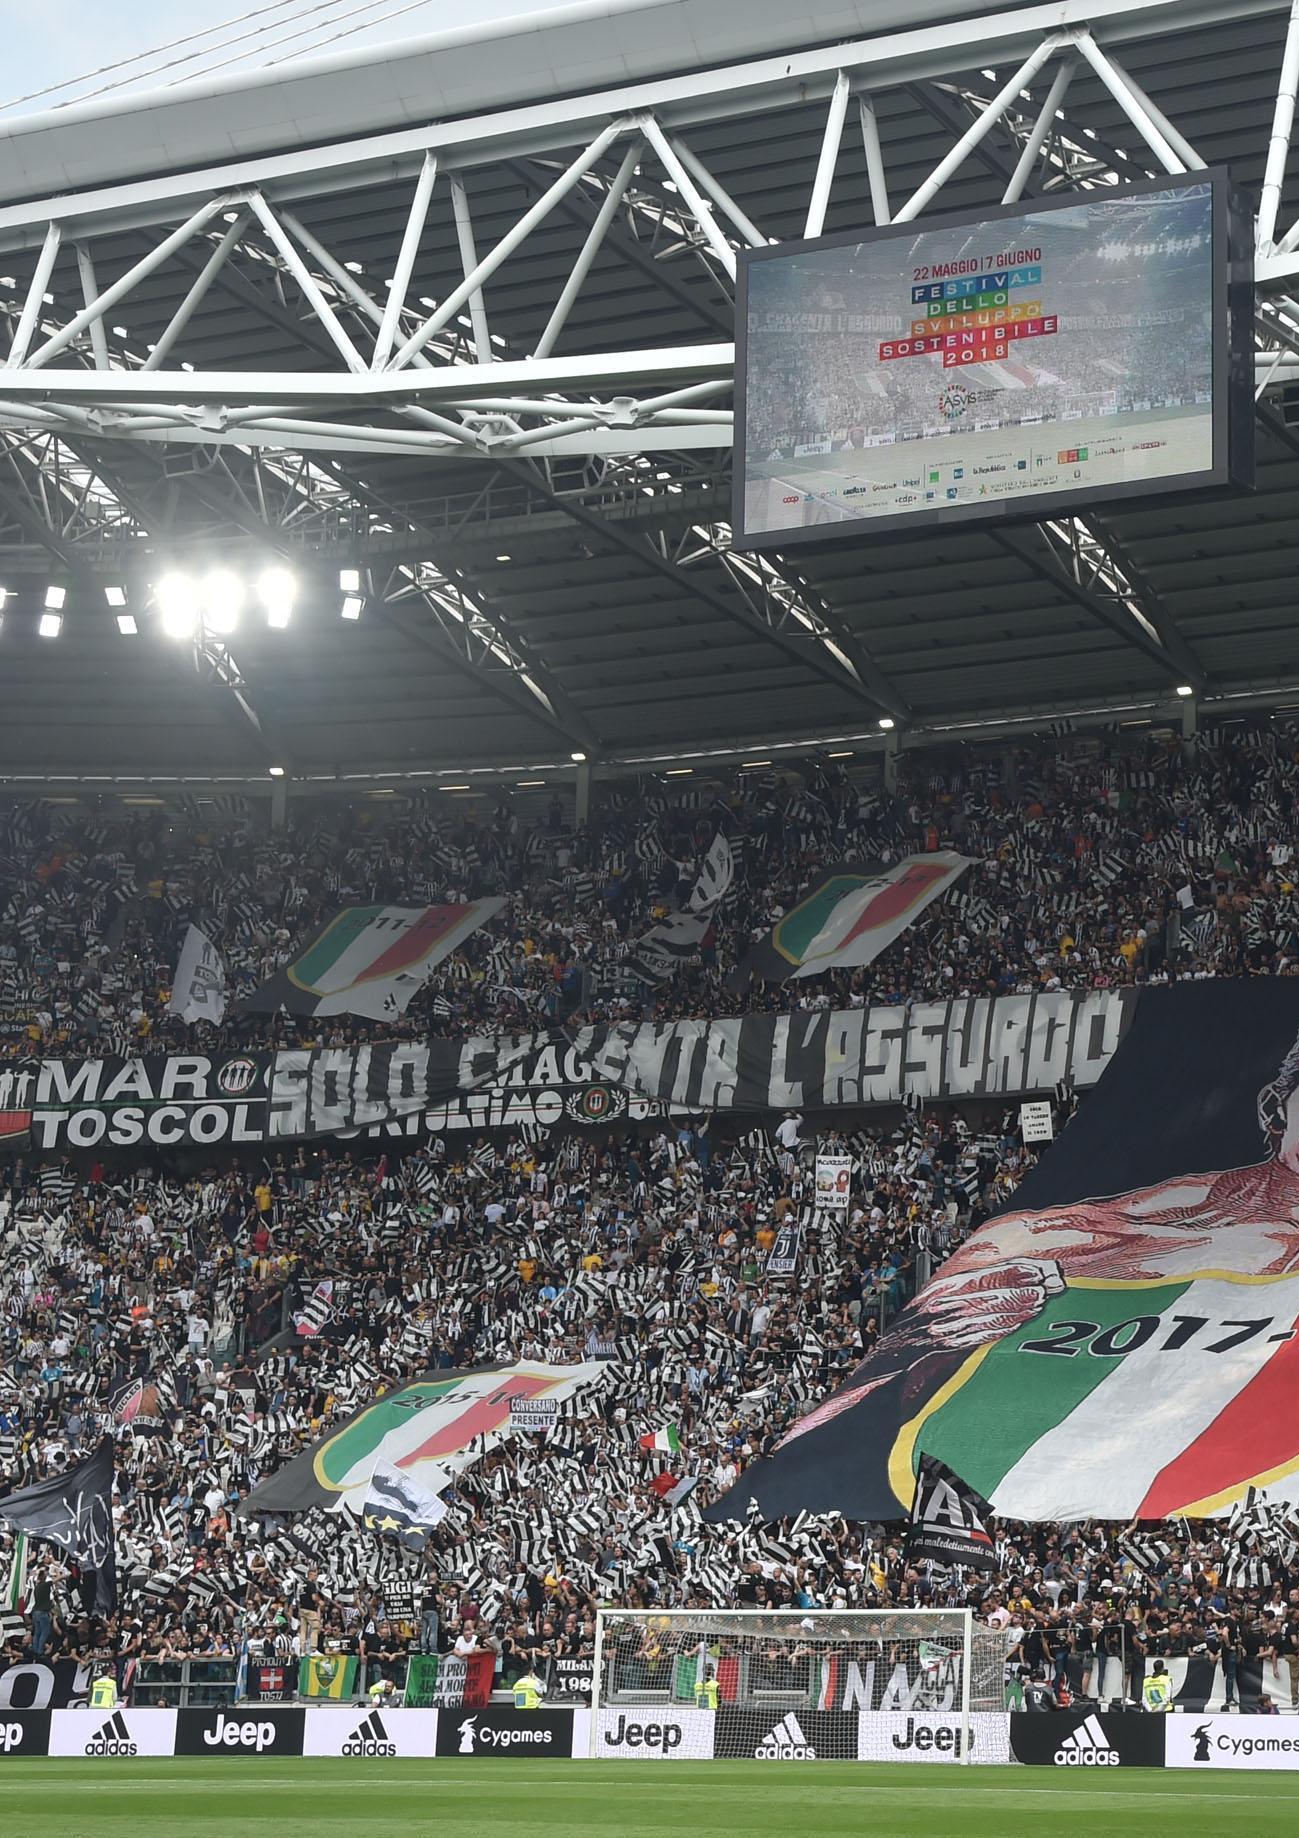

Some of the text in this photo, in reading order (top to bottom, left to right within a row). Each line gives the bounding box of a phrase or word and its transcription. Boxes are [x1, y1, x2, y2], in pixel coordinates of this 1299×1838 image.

[914, 248, 1042, 281] 22 MAGGIO 7 GIUGNO
[914, 271, 1038, 300] FESTIVAL
[930, 292, 1006, 315] DELLO
[914, 304, 1040, 335] SVILUPPO
[882, 319, 1056, 357] SOSTENIBILE
[946, 344, 1004, 365] 2018
[767, 989, 1123, 1107] L'ASSURDO
[268, 1041, 430, 1137] SOLO
[511, 1415, 556, 1426] PRESENTE
[85, 1739, 138, 1756] adidas
[203, 1714, 276, 1752] Jeep
[480, 1727, 553, 1748] Cygames
[604, 1714, 682, 1753] Jeep
[892, 1718, 975, 1758] Jeep
[341, 1739, 397, 1757] adidas
[754, 1742, 816, 1760] adidas
[1053, 1746, 1120, 1766] adidas
